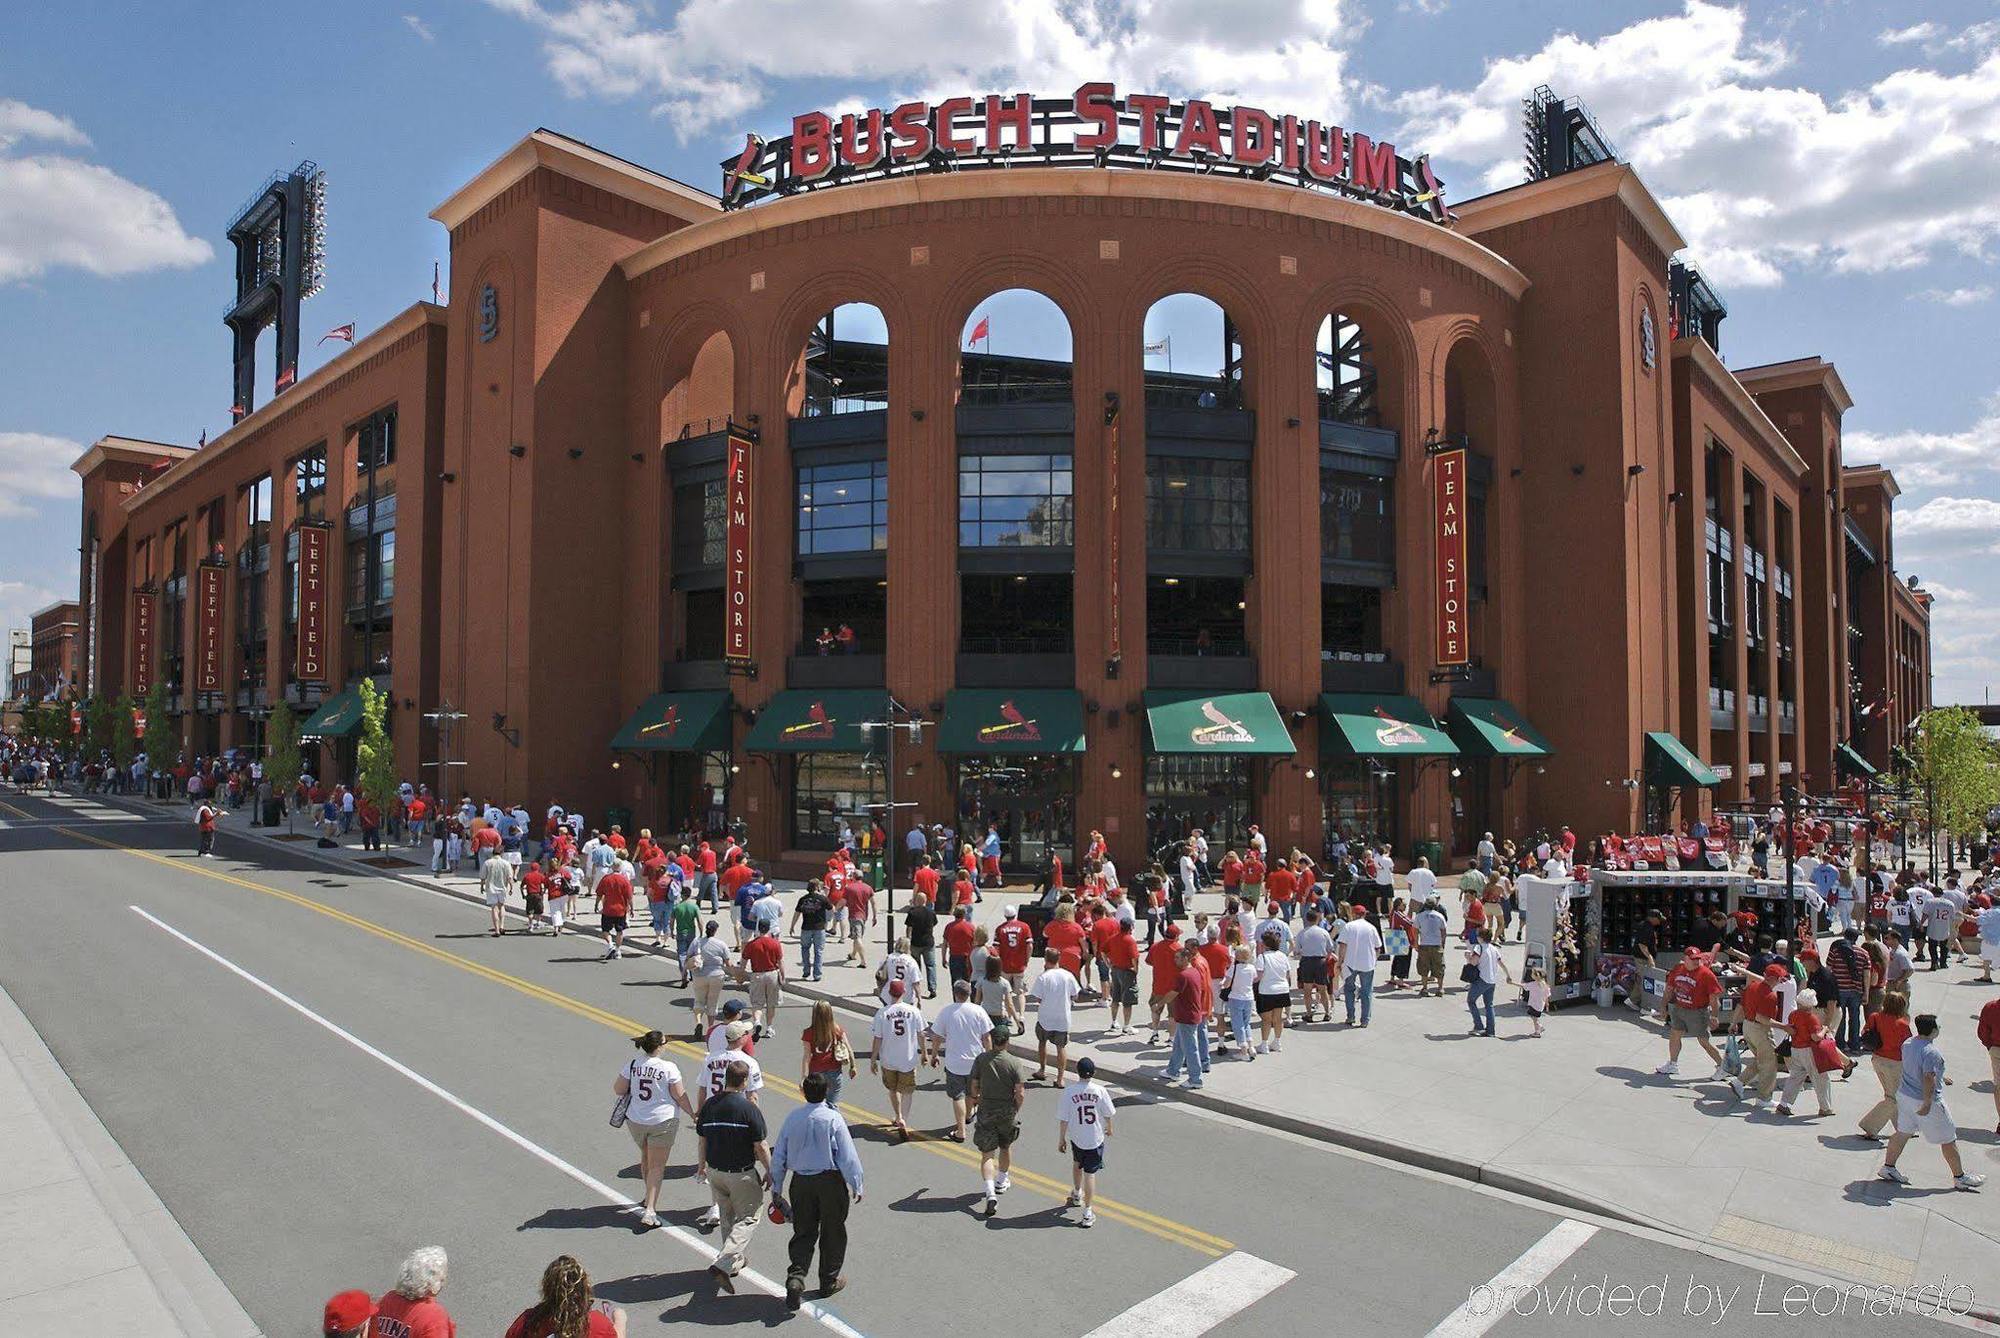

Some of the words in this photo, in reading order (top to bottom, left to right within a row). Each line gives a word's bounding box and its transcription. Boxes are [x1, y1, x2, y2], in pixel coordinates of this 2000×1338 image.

[792, 93, 1036, 181] BUSCH
[1073, 82, 1401, 202] STADIUM
[734, 448, 745, 526] TEAM
[1443, 461, 1458, 536] TEAM
[308, 533, 319, 590] LEFT
[139, 598, 148, 636] LEFT
[207, 572, 216, 618] LEFT
[734, 550, 744, 648] STORE
[1445, 558, 1458, 655] STORE
[206, 626, 216, 685] FIELD
[306, 601, 318, 673] FIELD
[138, 643, 147, 693] FIELD
[1915, 895, 1924, 905] 5
[1935, 908, 1950, 920] 12
[1008, 933, 1018, 948] 5
[895, 965, 905, 980] 5
[894, 1020, 905, 1036] 5
[631, 1066, 665, 1081] PUJOLS
[638, 1079, 653, 1101] 5
[1076, 1105, 1097, 1125] 15
